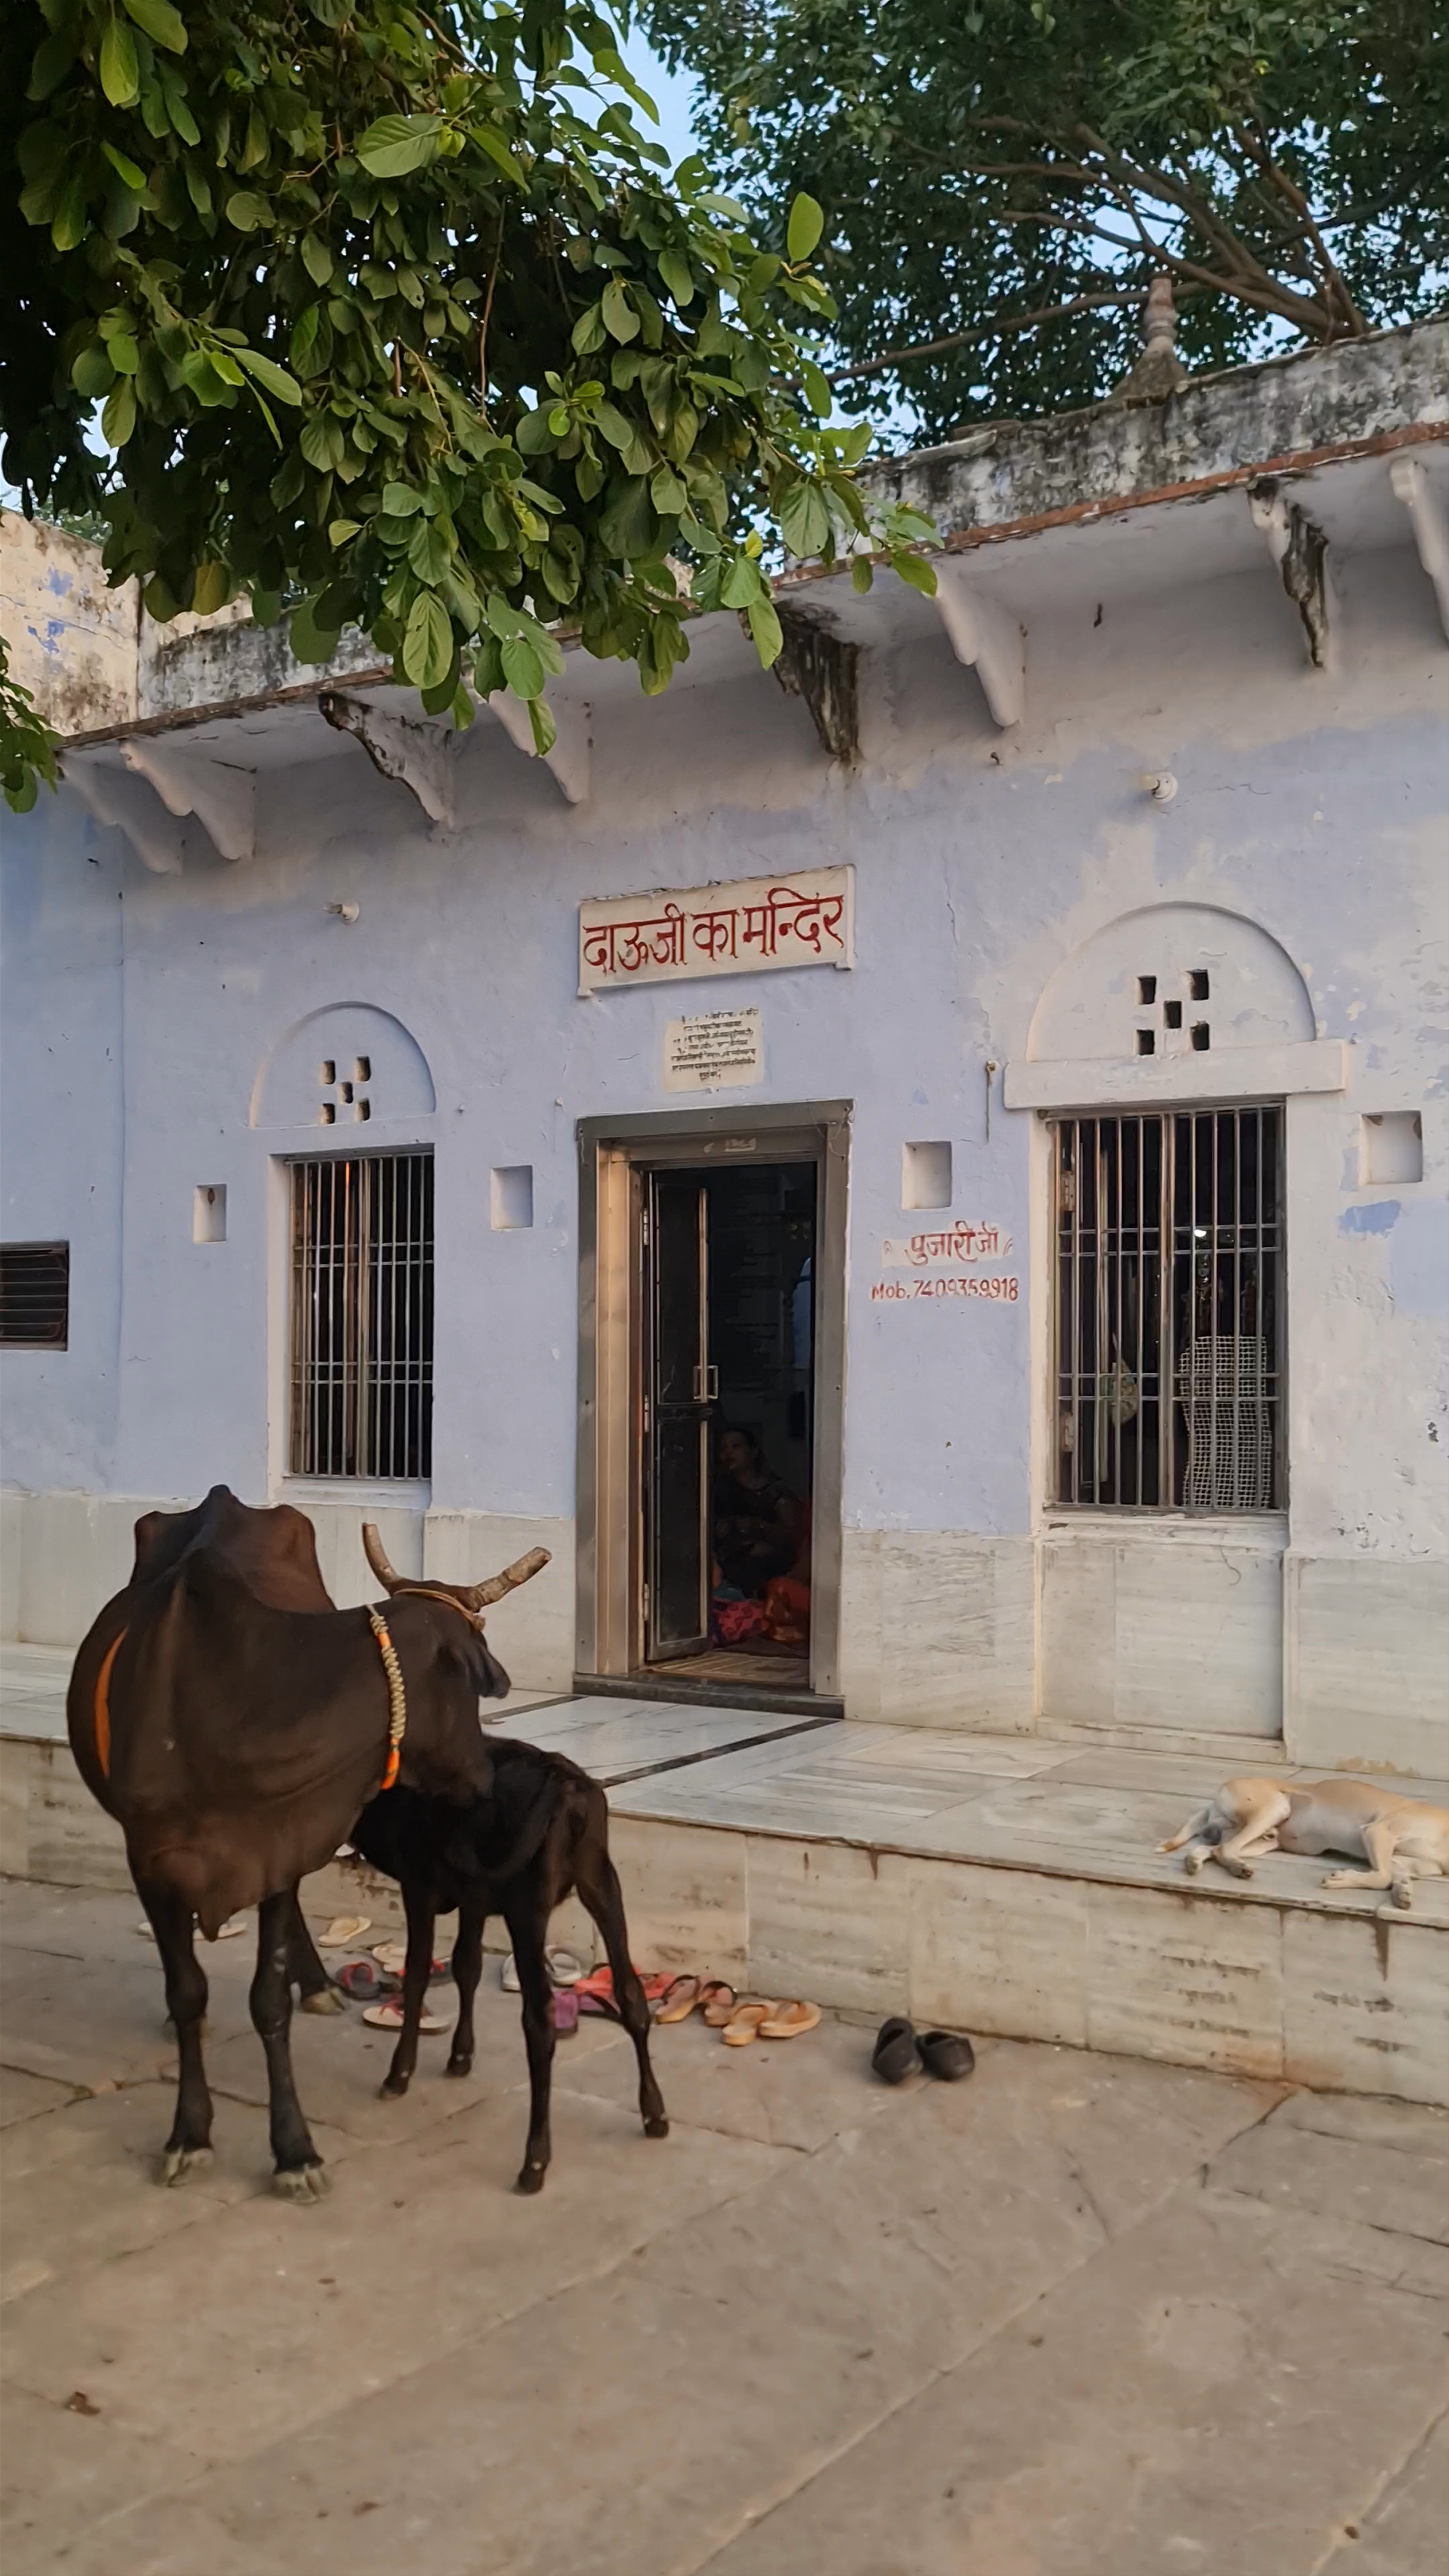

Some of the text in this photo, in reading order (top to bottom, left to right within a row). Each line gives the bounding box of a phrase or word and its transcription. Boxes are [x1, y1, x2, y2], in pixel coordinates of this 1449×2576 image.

[582, 887, 845, 973] दाऊजी का मन्दिर
